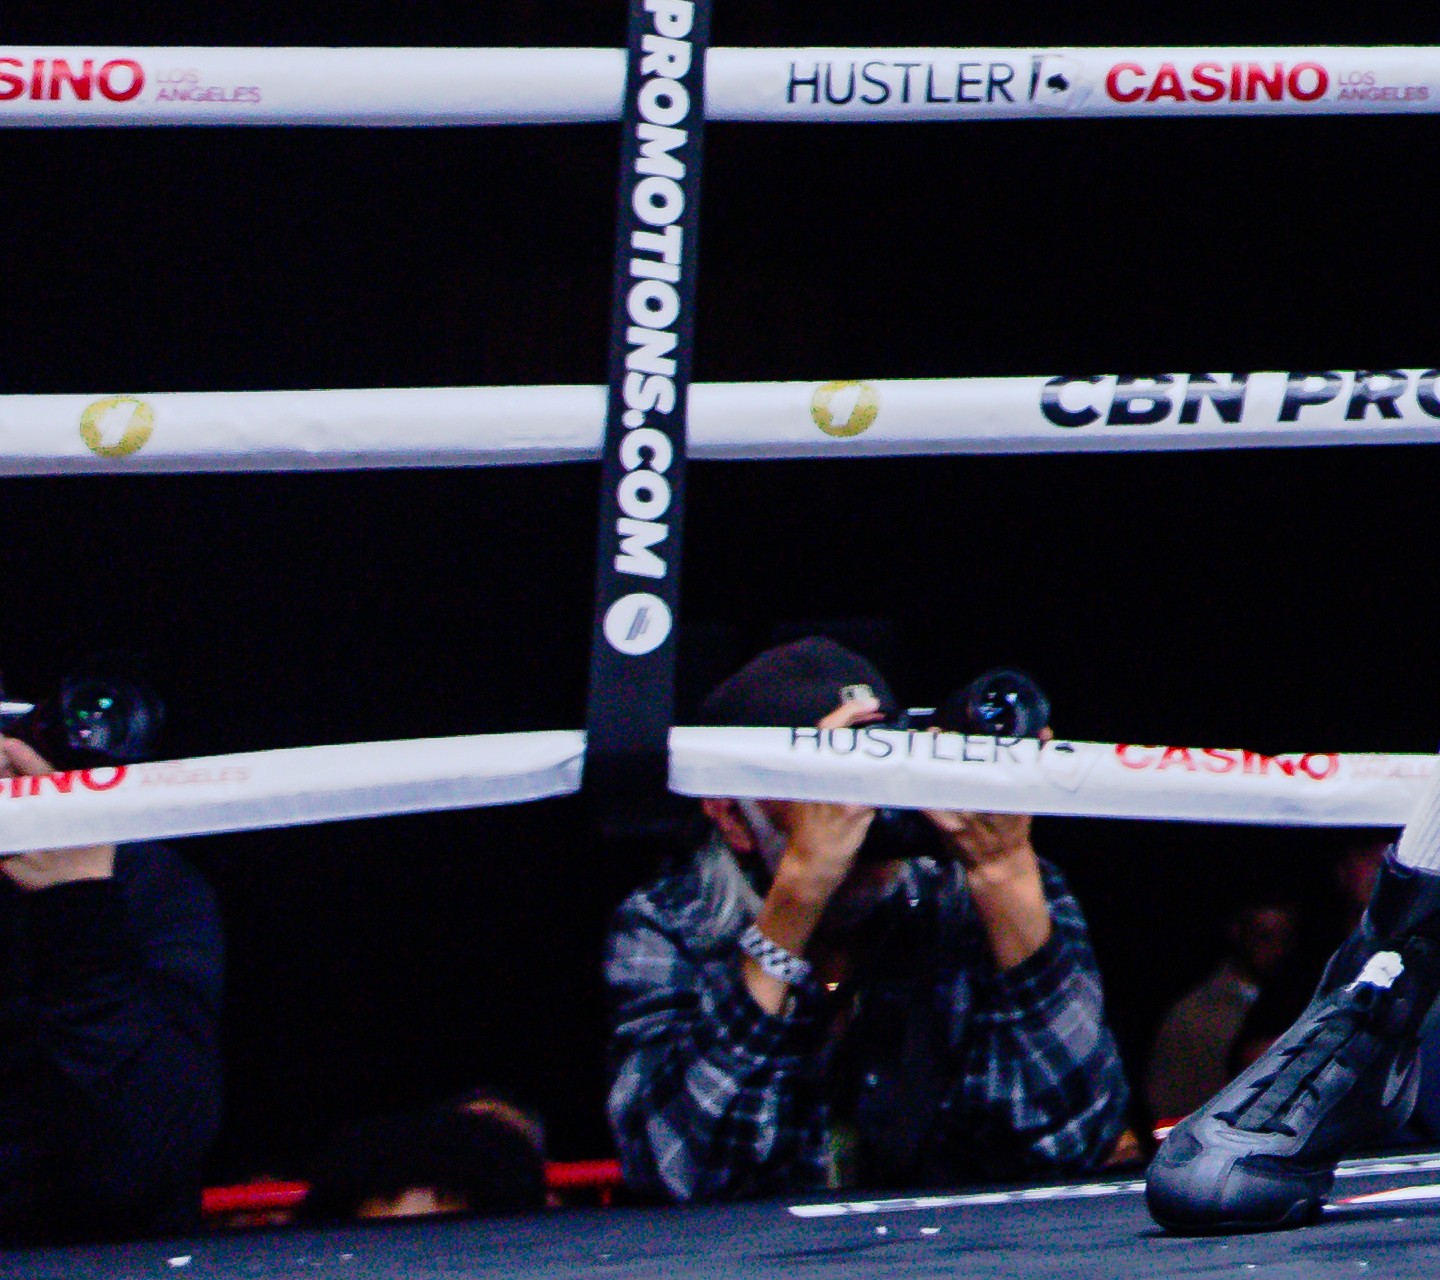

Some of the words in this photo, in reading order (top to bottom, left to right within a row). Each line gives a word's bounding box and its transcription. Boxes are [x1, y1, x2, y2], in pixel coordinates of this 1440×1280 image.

[0, 57, 146, 103] SINO
[786, 60, 1016, 104] HUSTLER
[1105, 60, 1330, 103] CASINO
[1337, 70, 1377, 86] LOS
[1039, 373, 1252, 428] CBN
